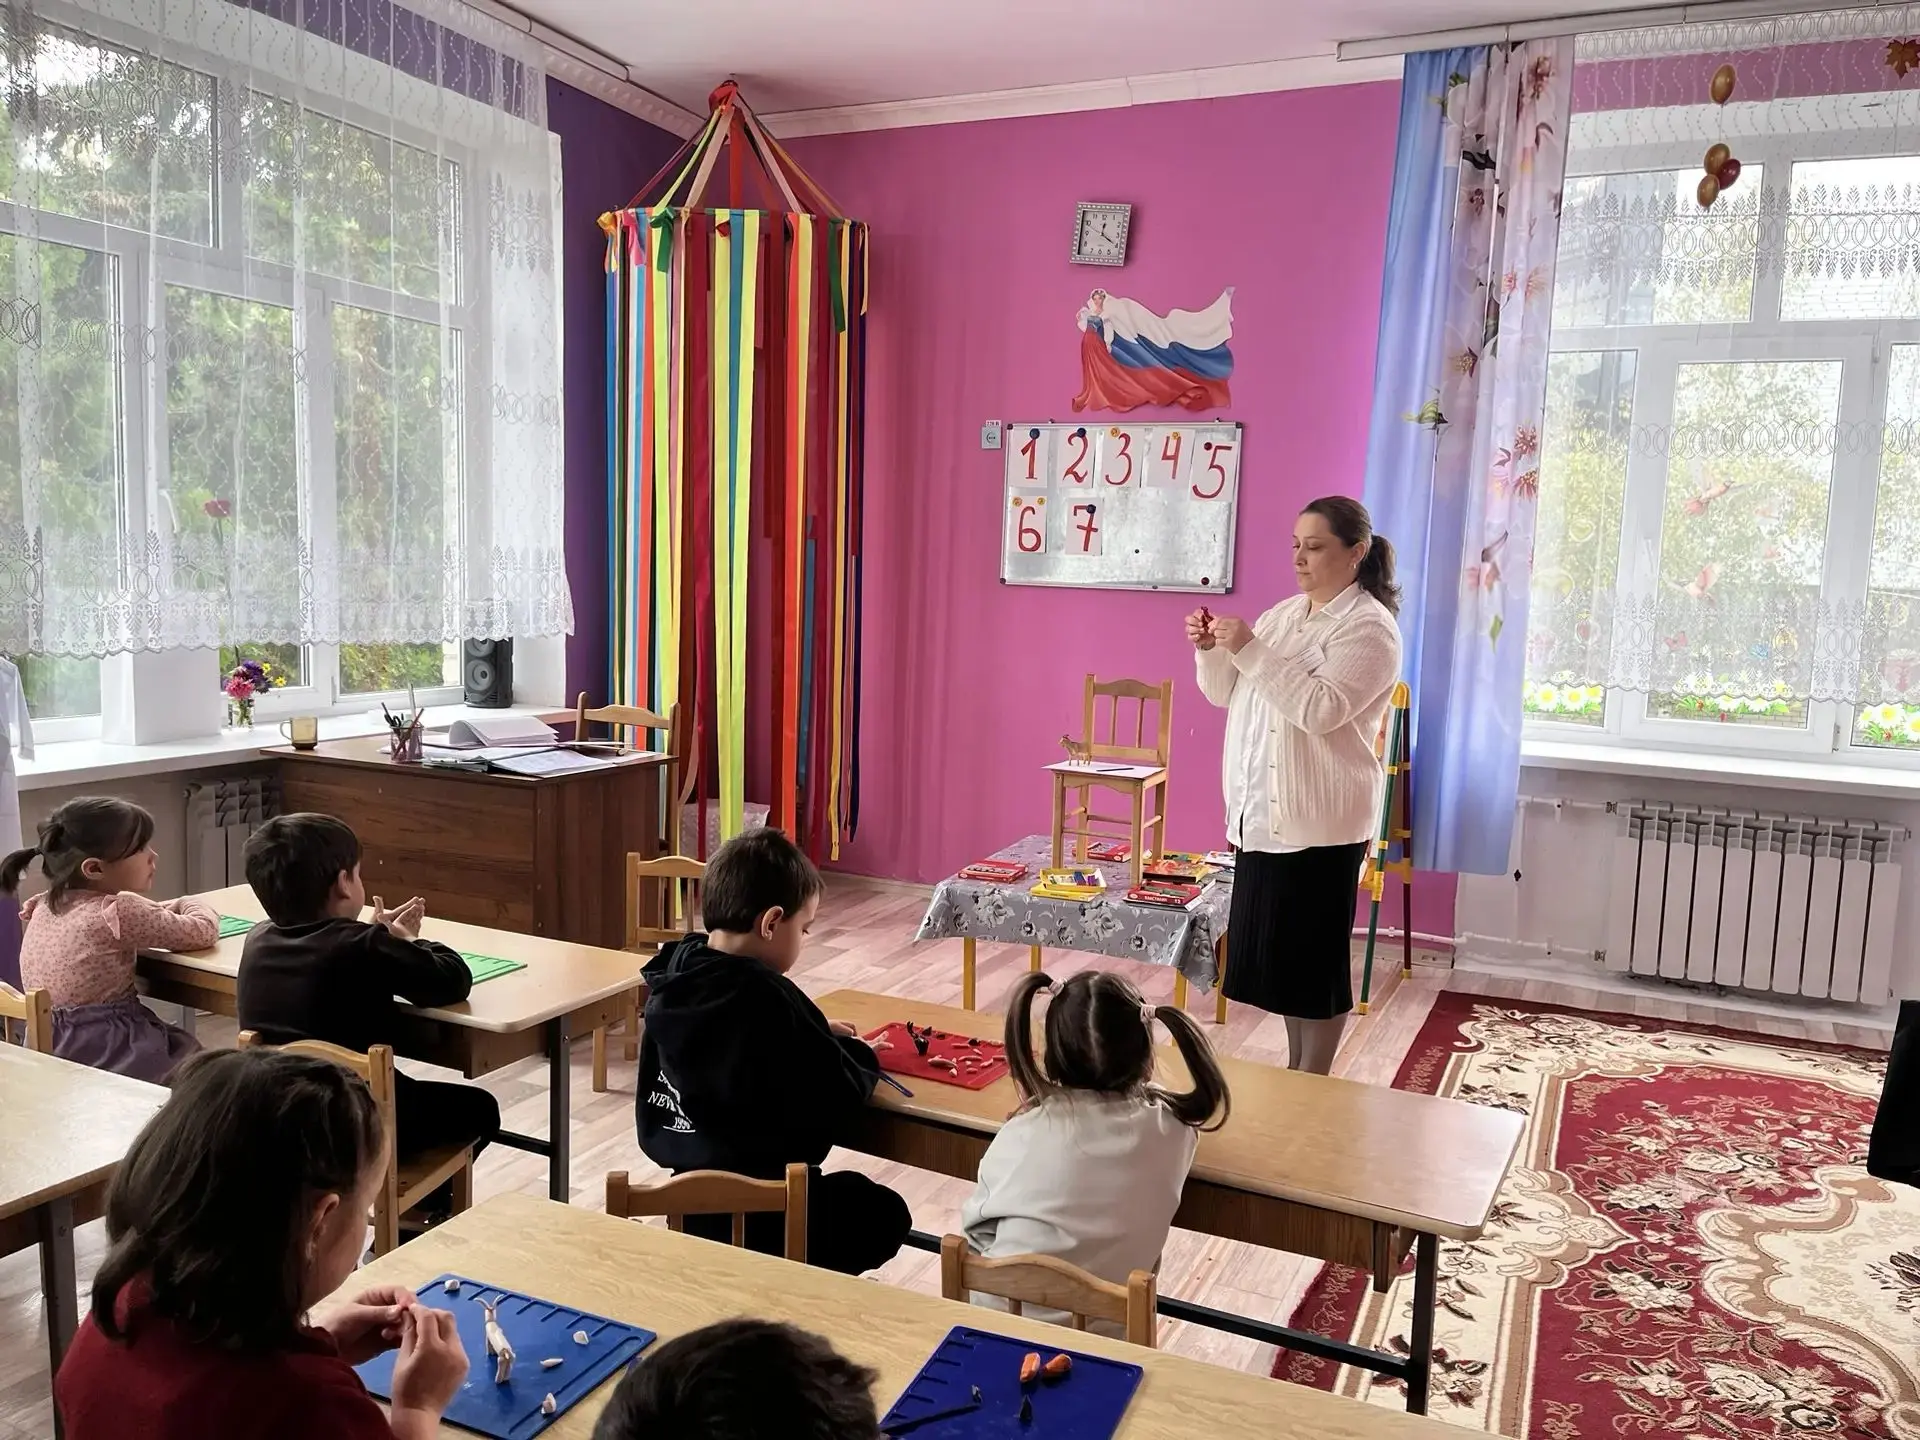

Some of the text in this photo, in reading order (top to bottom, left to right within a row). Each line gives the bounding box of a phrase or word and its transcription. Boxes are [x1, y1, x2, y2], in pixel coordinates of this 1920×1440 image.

[1020, 431, 1233, 499] 1 2 3 4 5
[1018, 505, 1099, 552] 6 7
